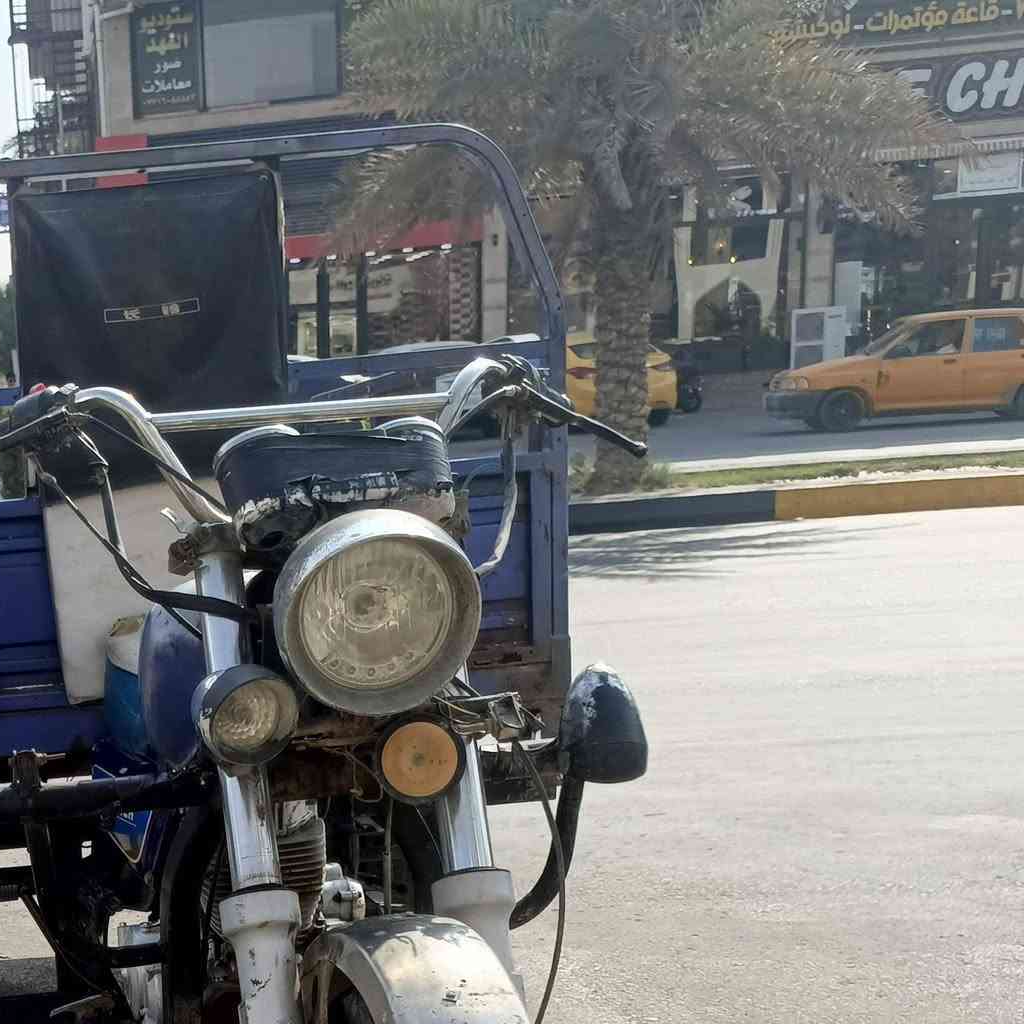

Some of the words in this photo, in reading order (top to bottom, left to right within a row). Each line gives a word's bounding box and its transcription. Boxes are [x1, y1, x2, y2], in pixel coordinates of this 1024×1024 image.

[866, 1, 948, 35] مؤتمرات
[951, 0, 1000, 24] قاعة
[141, 78, 192, 94] معاملات
